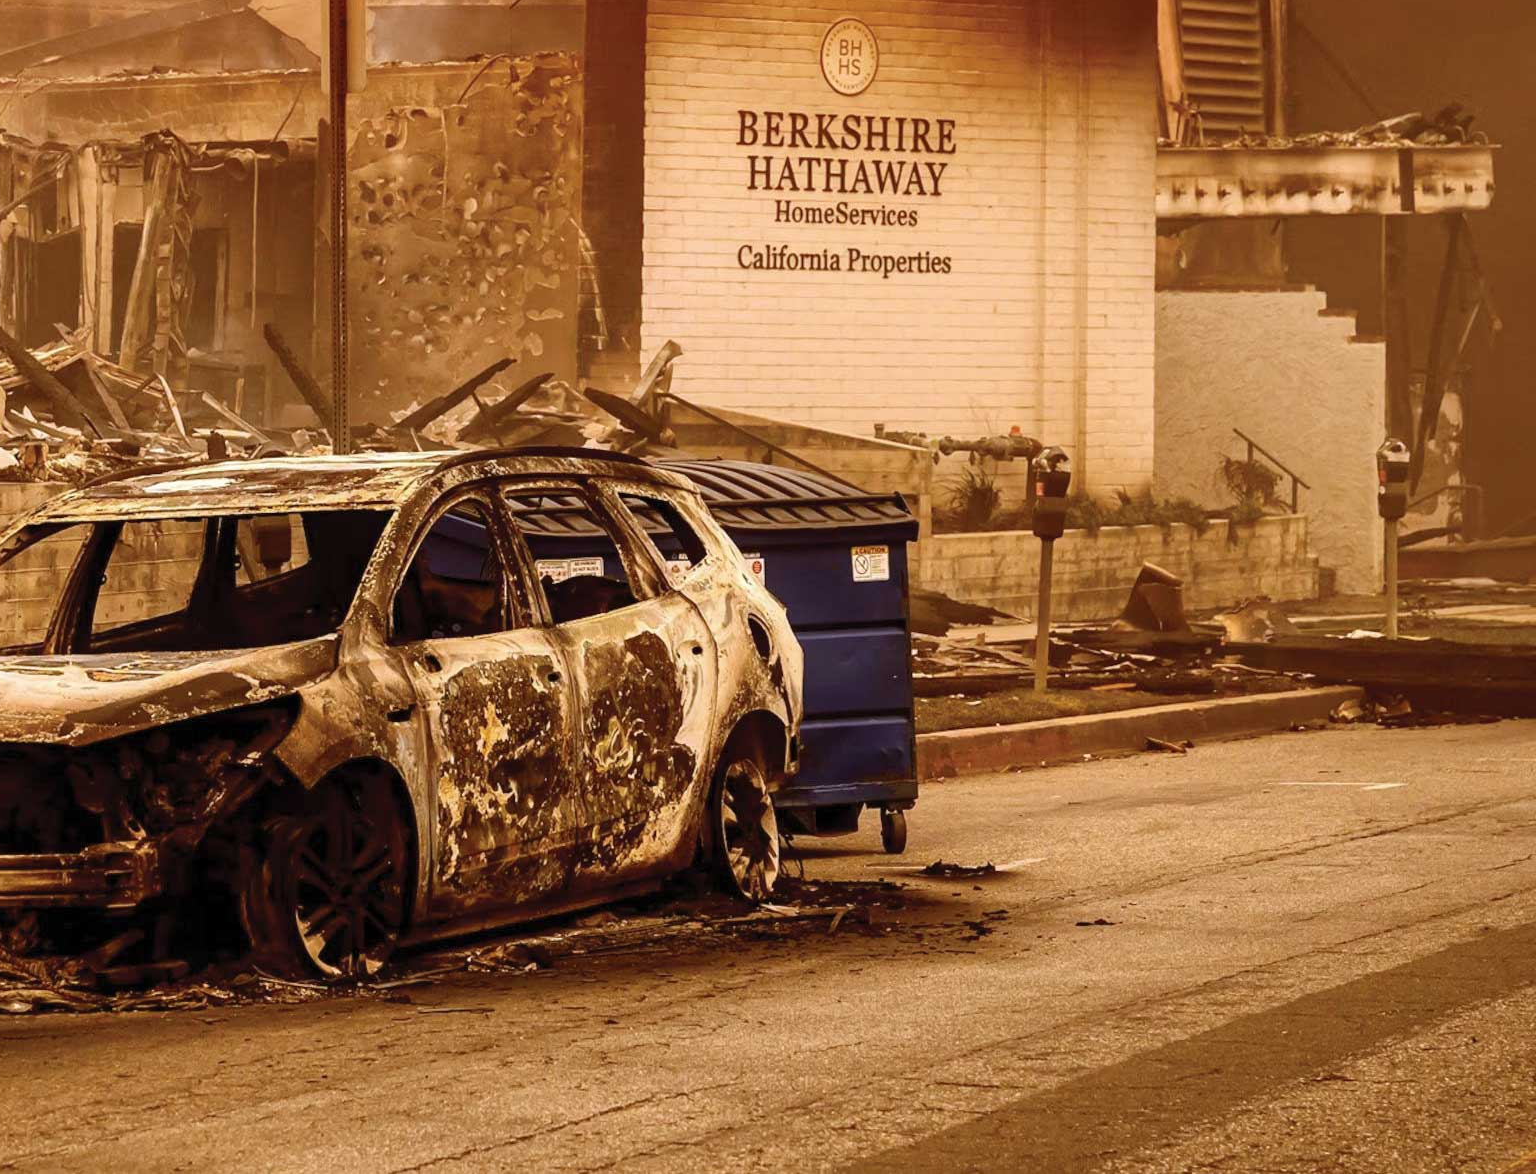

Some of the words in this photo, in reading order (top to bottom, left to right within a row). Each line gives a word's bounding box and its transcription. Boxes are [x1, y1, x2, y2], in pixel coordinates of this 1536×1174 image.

[839, 39, 862, 56] BH
[838, 58, 861, 76] HS
[736, 110, 957, 155] BERKSHIRE
[747, 155, 948, 197] HATHAWAY
[774, 200, 918, 227] HomeServices
[737, 244, 841, 272] California
[846, 248, 952, 279] Properties
